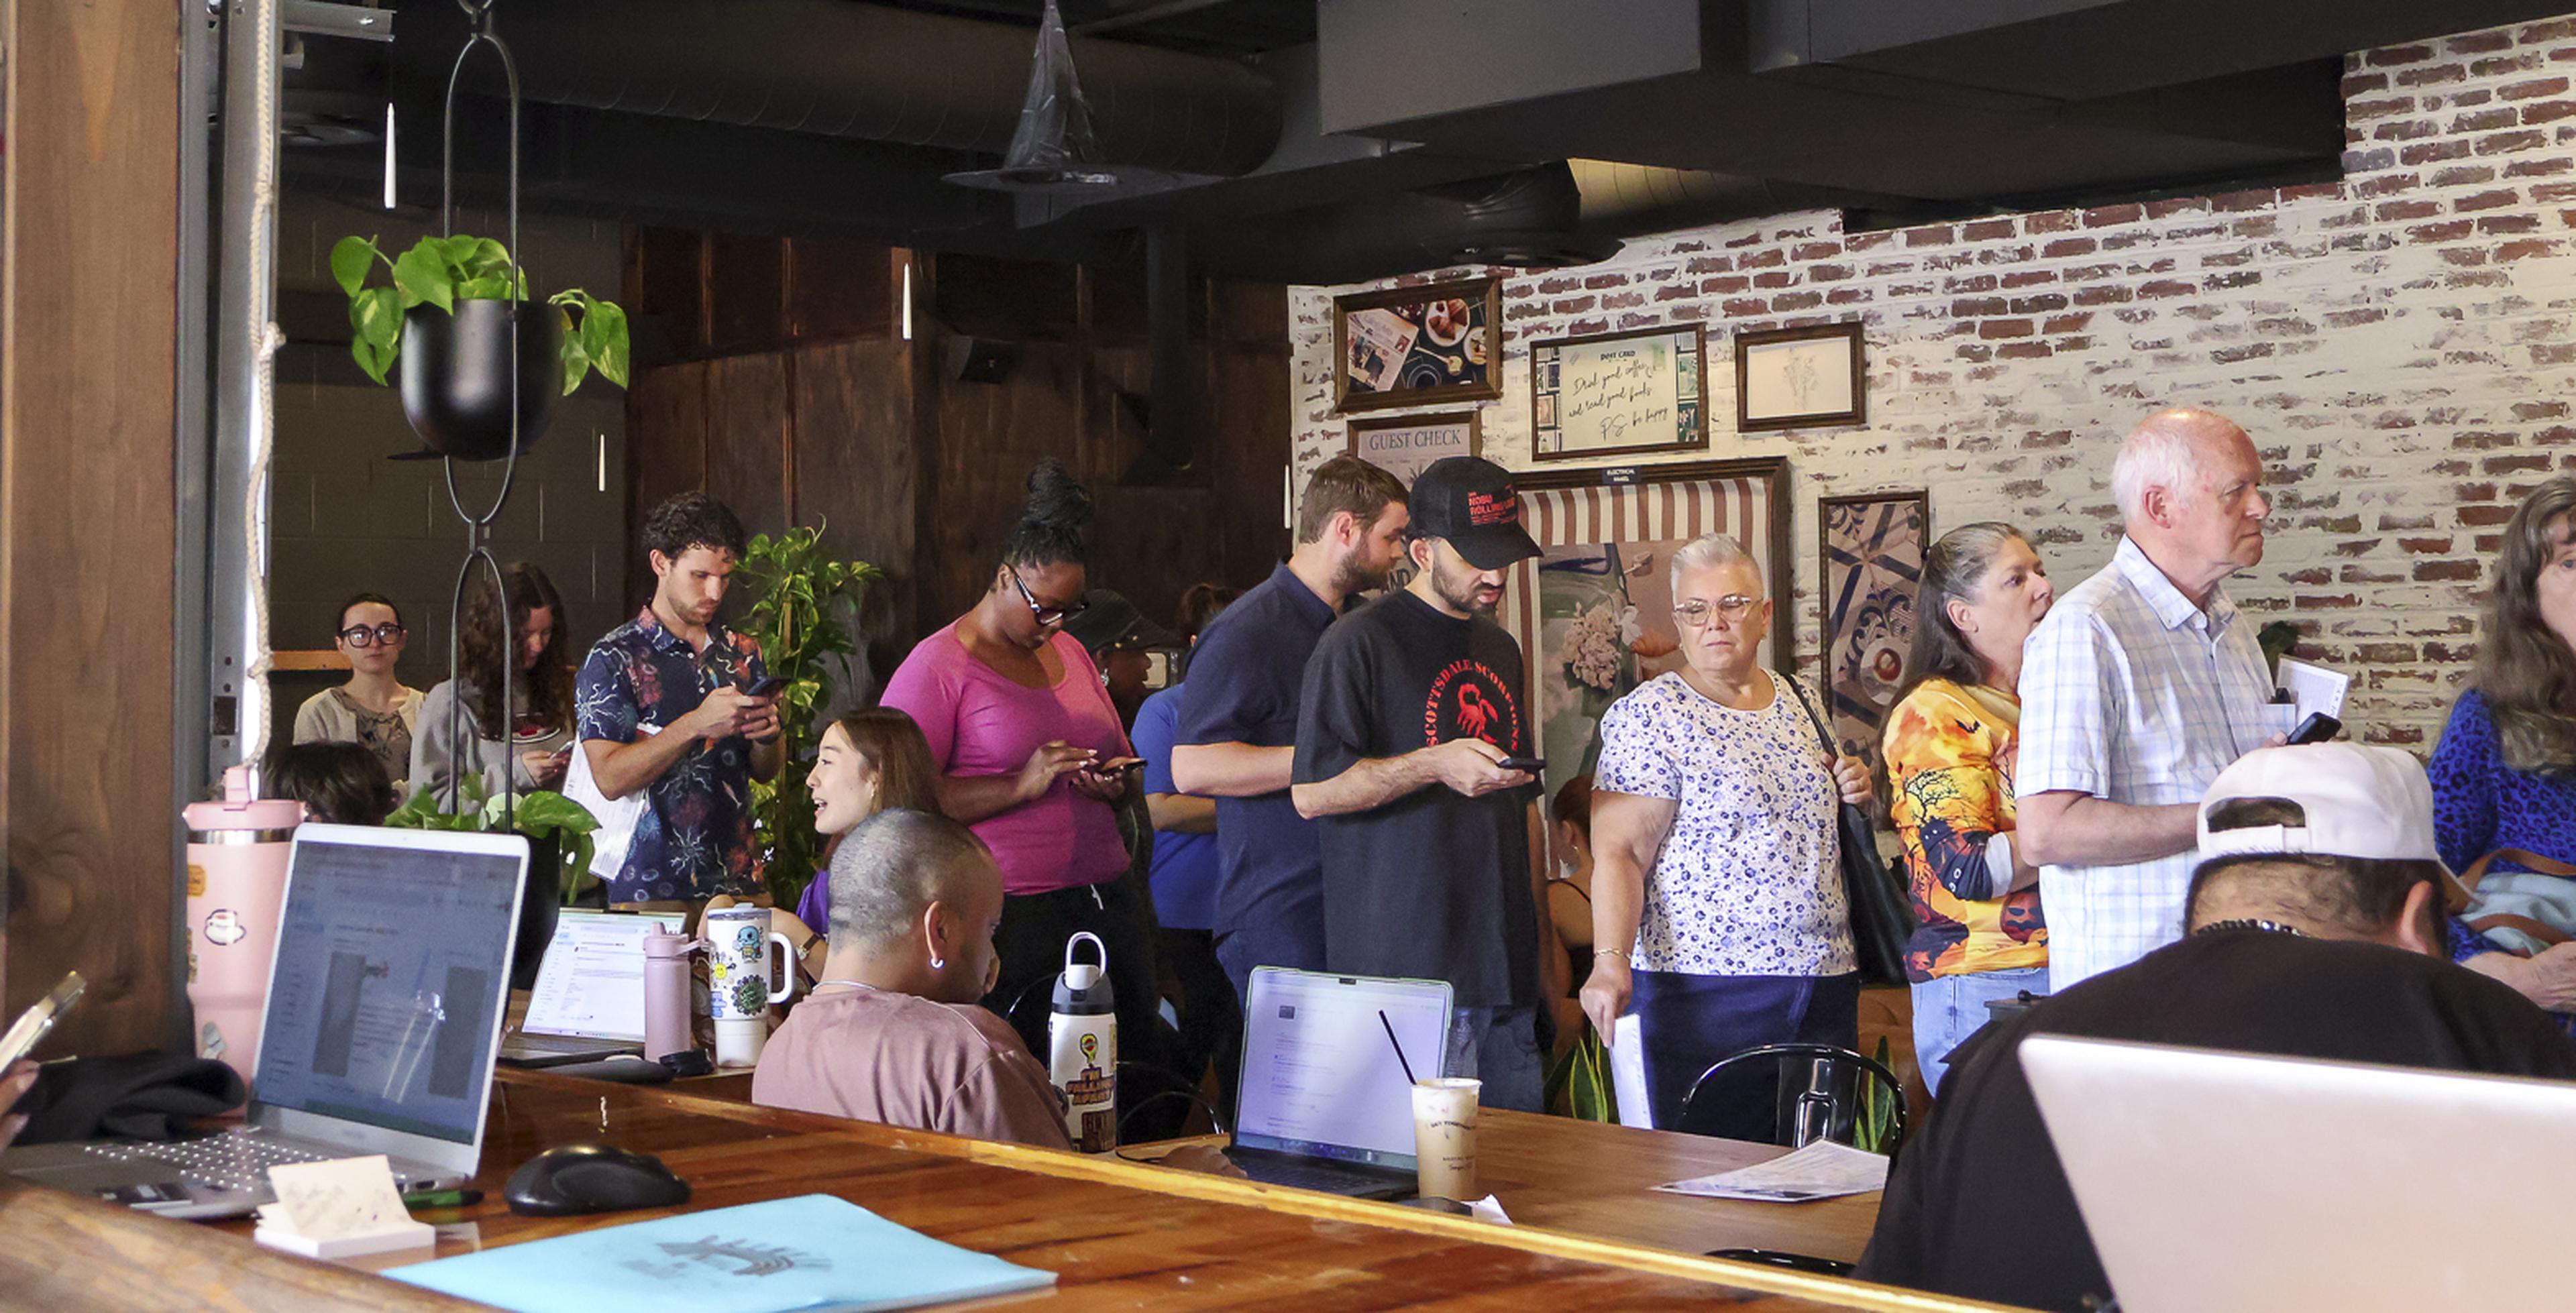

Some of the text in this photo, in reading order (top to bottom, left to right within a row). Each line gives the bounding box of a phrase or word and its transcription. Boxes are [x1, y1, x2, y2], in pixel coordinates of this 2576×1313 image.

[1601, 350, 1636, 361] POST CARD
[1602, 366, 1622, 389] good
[1607, 386, 1627, 409] good
[1632, 411, 1642, 426] be
[1646, 408, 1668, 422] happy
[1369, 429, 1460, 450] GUEST CHECK
[1424, 659, 1472, 748] SCOTTSDALE
